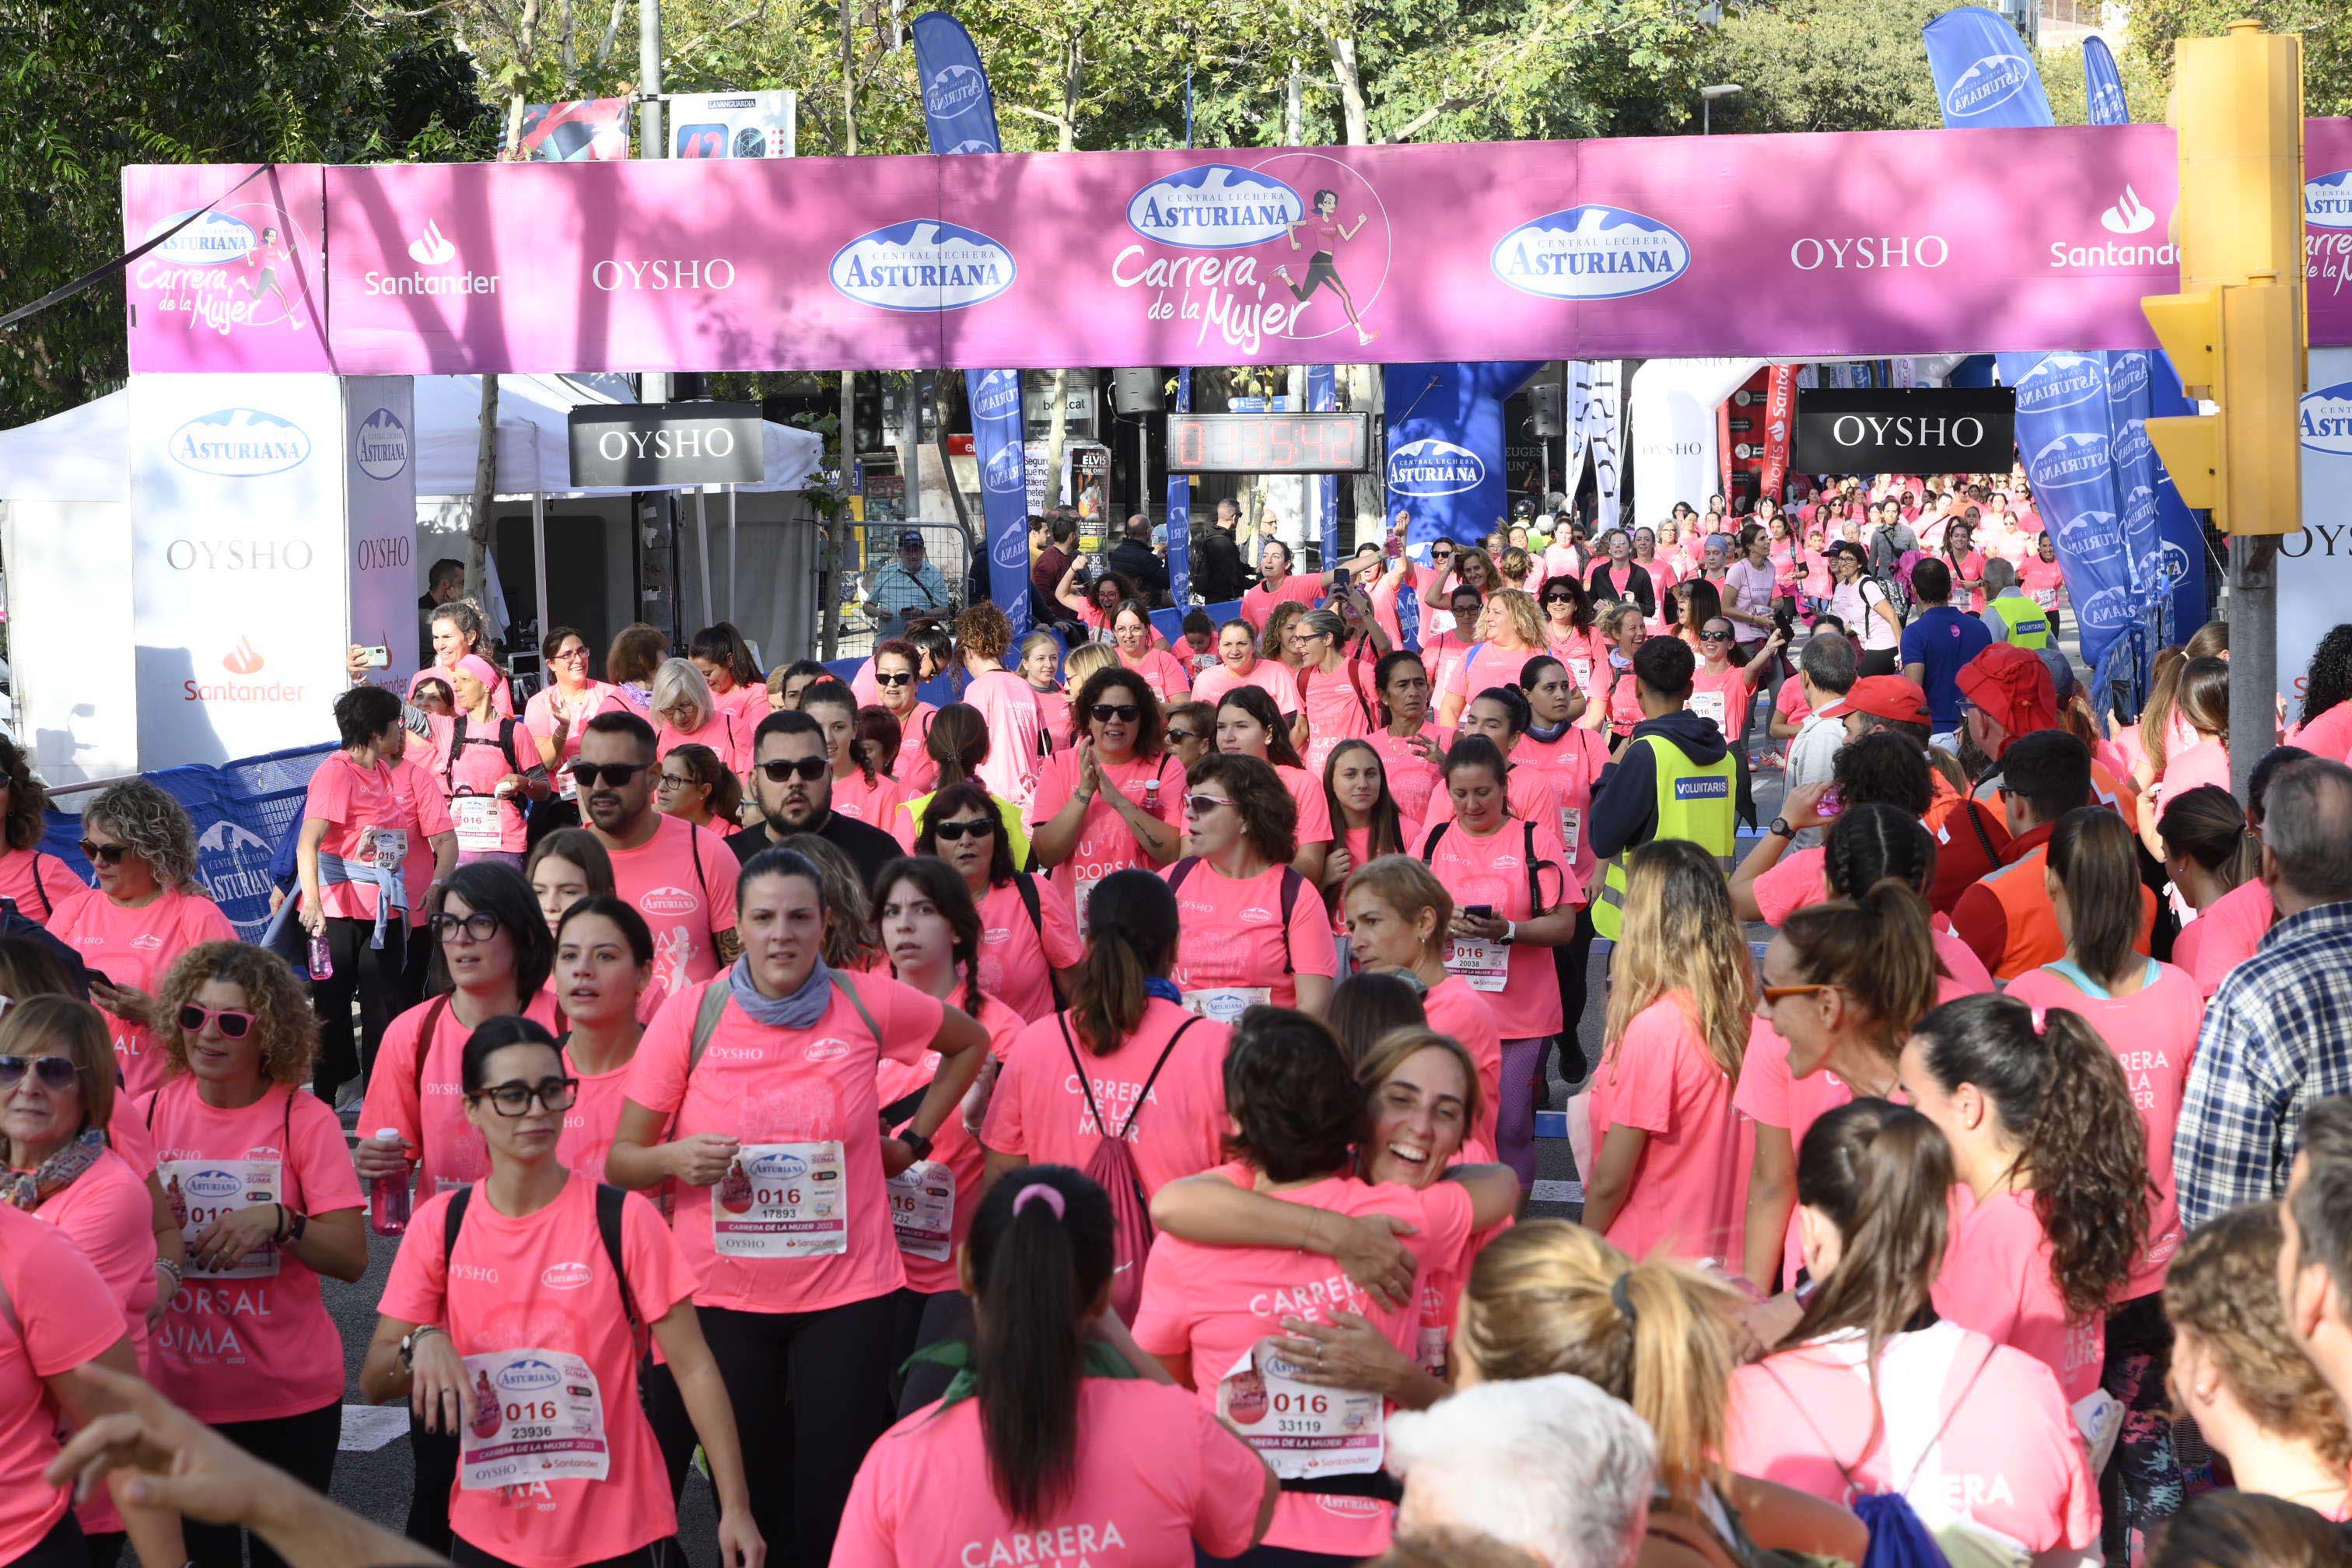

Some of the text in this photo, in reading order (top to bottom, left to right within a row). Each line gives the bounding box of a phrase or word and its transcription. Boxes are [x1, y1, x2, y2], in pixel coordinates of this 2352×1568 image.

[716, 99, 755, 108] VANGUARDIA
[1229, 192, 1285, 201] LECHERA
[1141, 196, 1290, 227] ASTURIANA
[1538, 236, 1668, 248] CENTRAL LECHERA
[873, 250, 996, 261] CENTRAL LECHERA
[1508, 242, 1675, 276] ASTURIANA
[1791, 236, 1948, 269] OYSHO
[136, 261, 228, 289] Carrera
[593, 258, 735, 291] OYSHO
[844, 254, 1002, 287] ASTURIANA
[1112, 245, 1258, 288] Carrera
[365, 270, 501, 296] Santander
[159, 289, 262, 335] de la Mujer
[1148, 289, 1200, 320] de la
[1197, 282, 1313, 355] Mujer
[1833, 415, 1983, 447] OYSHO
[180, 433, 300, 460] ASTURIANA
[360, 435, 405, 463] ASTURIANA
[599, 427, 734, 460] OYSHO
[1082, 455, 1106, 465] ELVIS
[1390, 462, 1478, 484] ASTURIANA
[166, 539, 313, 570] OYSHO
[358, 536, 410, 571] OYSHO
[1090, 555, 1101, 564] 30
[2017, 622, 2045, 632] VOLUNTARIS
[184, 679, 304, 702] Santander
[1676, 781, 1727, 795] VOLUNTARIS
[379, 852, 395, 860] 016
[645, 898, 695, 909] ASTURIANA
[1457, 947, 1483, 958] 016
[709, 1045, 763, 1059] OYSHO
[754, 1164, 803, 1173] ASTURIANA
[191, 1181, 236, 1192] ASTURIANA
[758, 1188, 801, 1205] 016
[894, 1195, 915, 1211] 16
[761, 1209, 796, 1219] 17893
[894, 1213, 909, 1225] 732
[726, 1238, 837, 1248] OYSHO Santander
[450, 1263, 499, 1283] YSHO
[170, 1286, 272, 1316] ORSAL
[158, 1322, 242, 1354] SIMA
[502, 1374, 557, 1385] ASTURIANA
[506, 1400, 557, 1421] 016
[1274, 1393, 1328, 1413] 016
[511, 1426, 552, 1440] 23936
[1278, 1419, 1321, 1432] 33119
[478, 1446, 516, 1460] CARRERA
[516, 1444, 529, 1452] DE
[530, 1443, 542, 1451] LA
[543, 1441, 573, 1451] MUJER
[1282, 1438, 1296, 1447] DE
[1297, 1438, 1310, 1447] LA
[1311, 1438, 1343, 1447] MUJER
[475, 1458, 598, 1481] OYSHO Santander
[1321, 1456, 1370, 1468] Santander
[961, 1519, 1127, 1568] CARRERA
